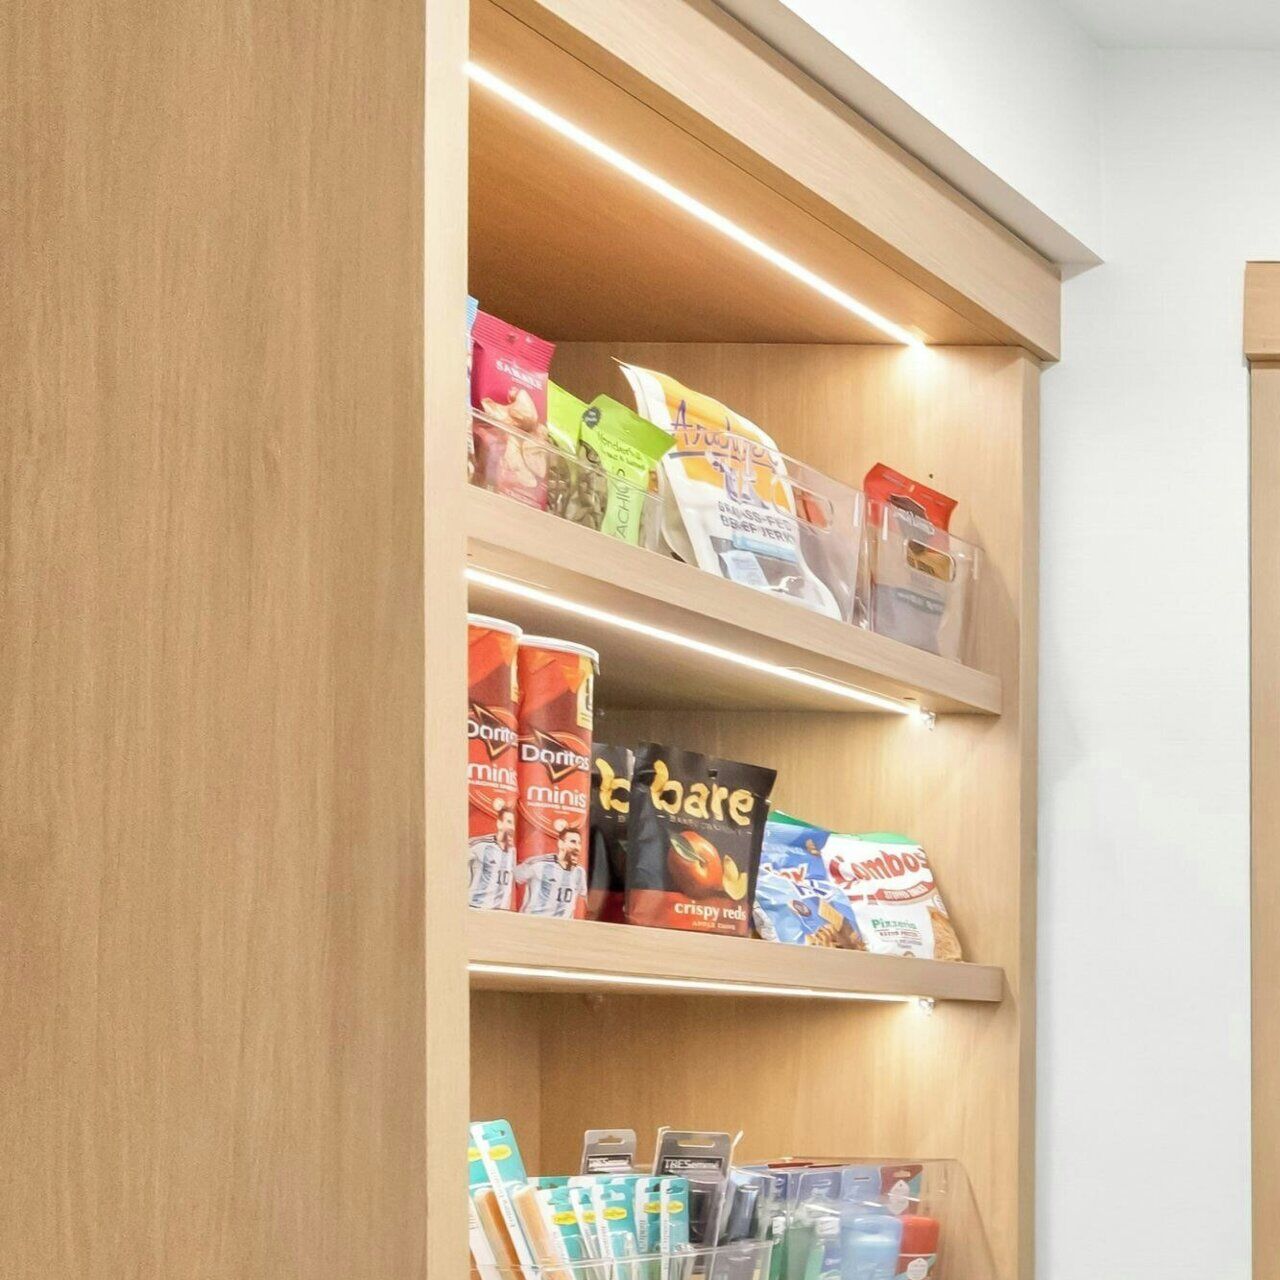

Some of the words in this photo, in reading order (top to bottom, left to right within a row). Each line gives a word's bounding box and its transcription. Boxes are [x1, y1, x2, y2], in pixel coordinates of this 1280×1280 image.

[521, 744, 590, 771] Doritos
[527, 785, 587, 808] minis
[651, 760, 755, 826] bare
[556, 887, 573, 903] 10
[674, 901, 721, 921] crispy
[723, 904, 748, 921] reds
